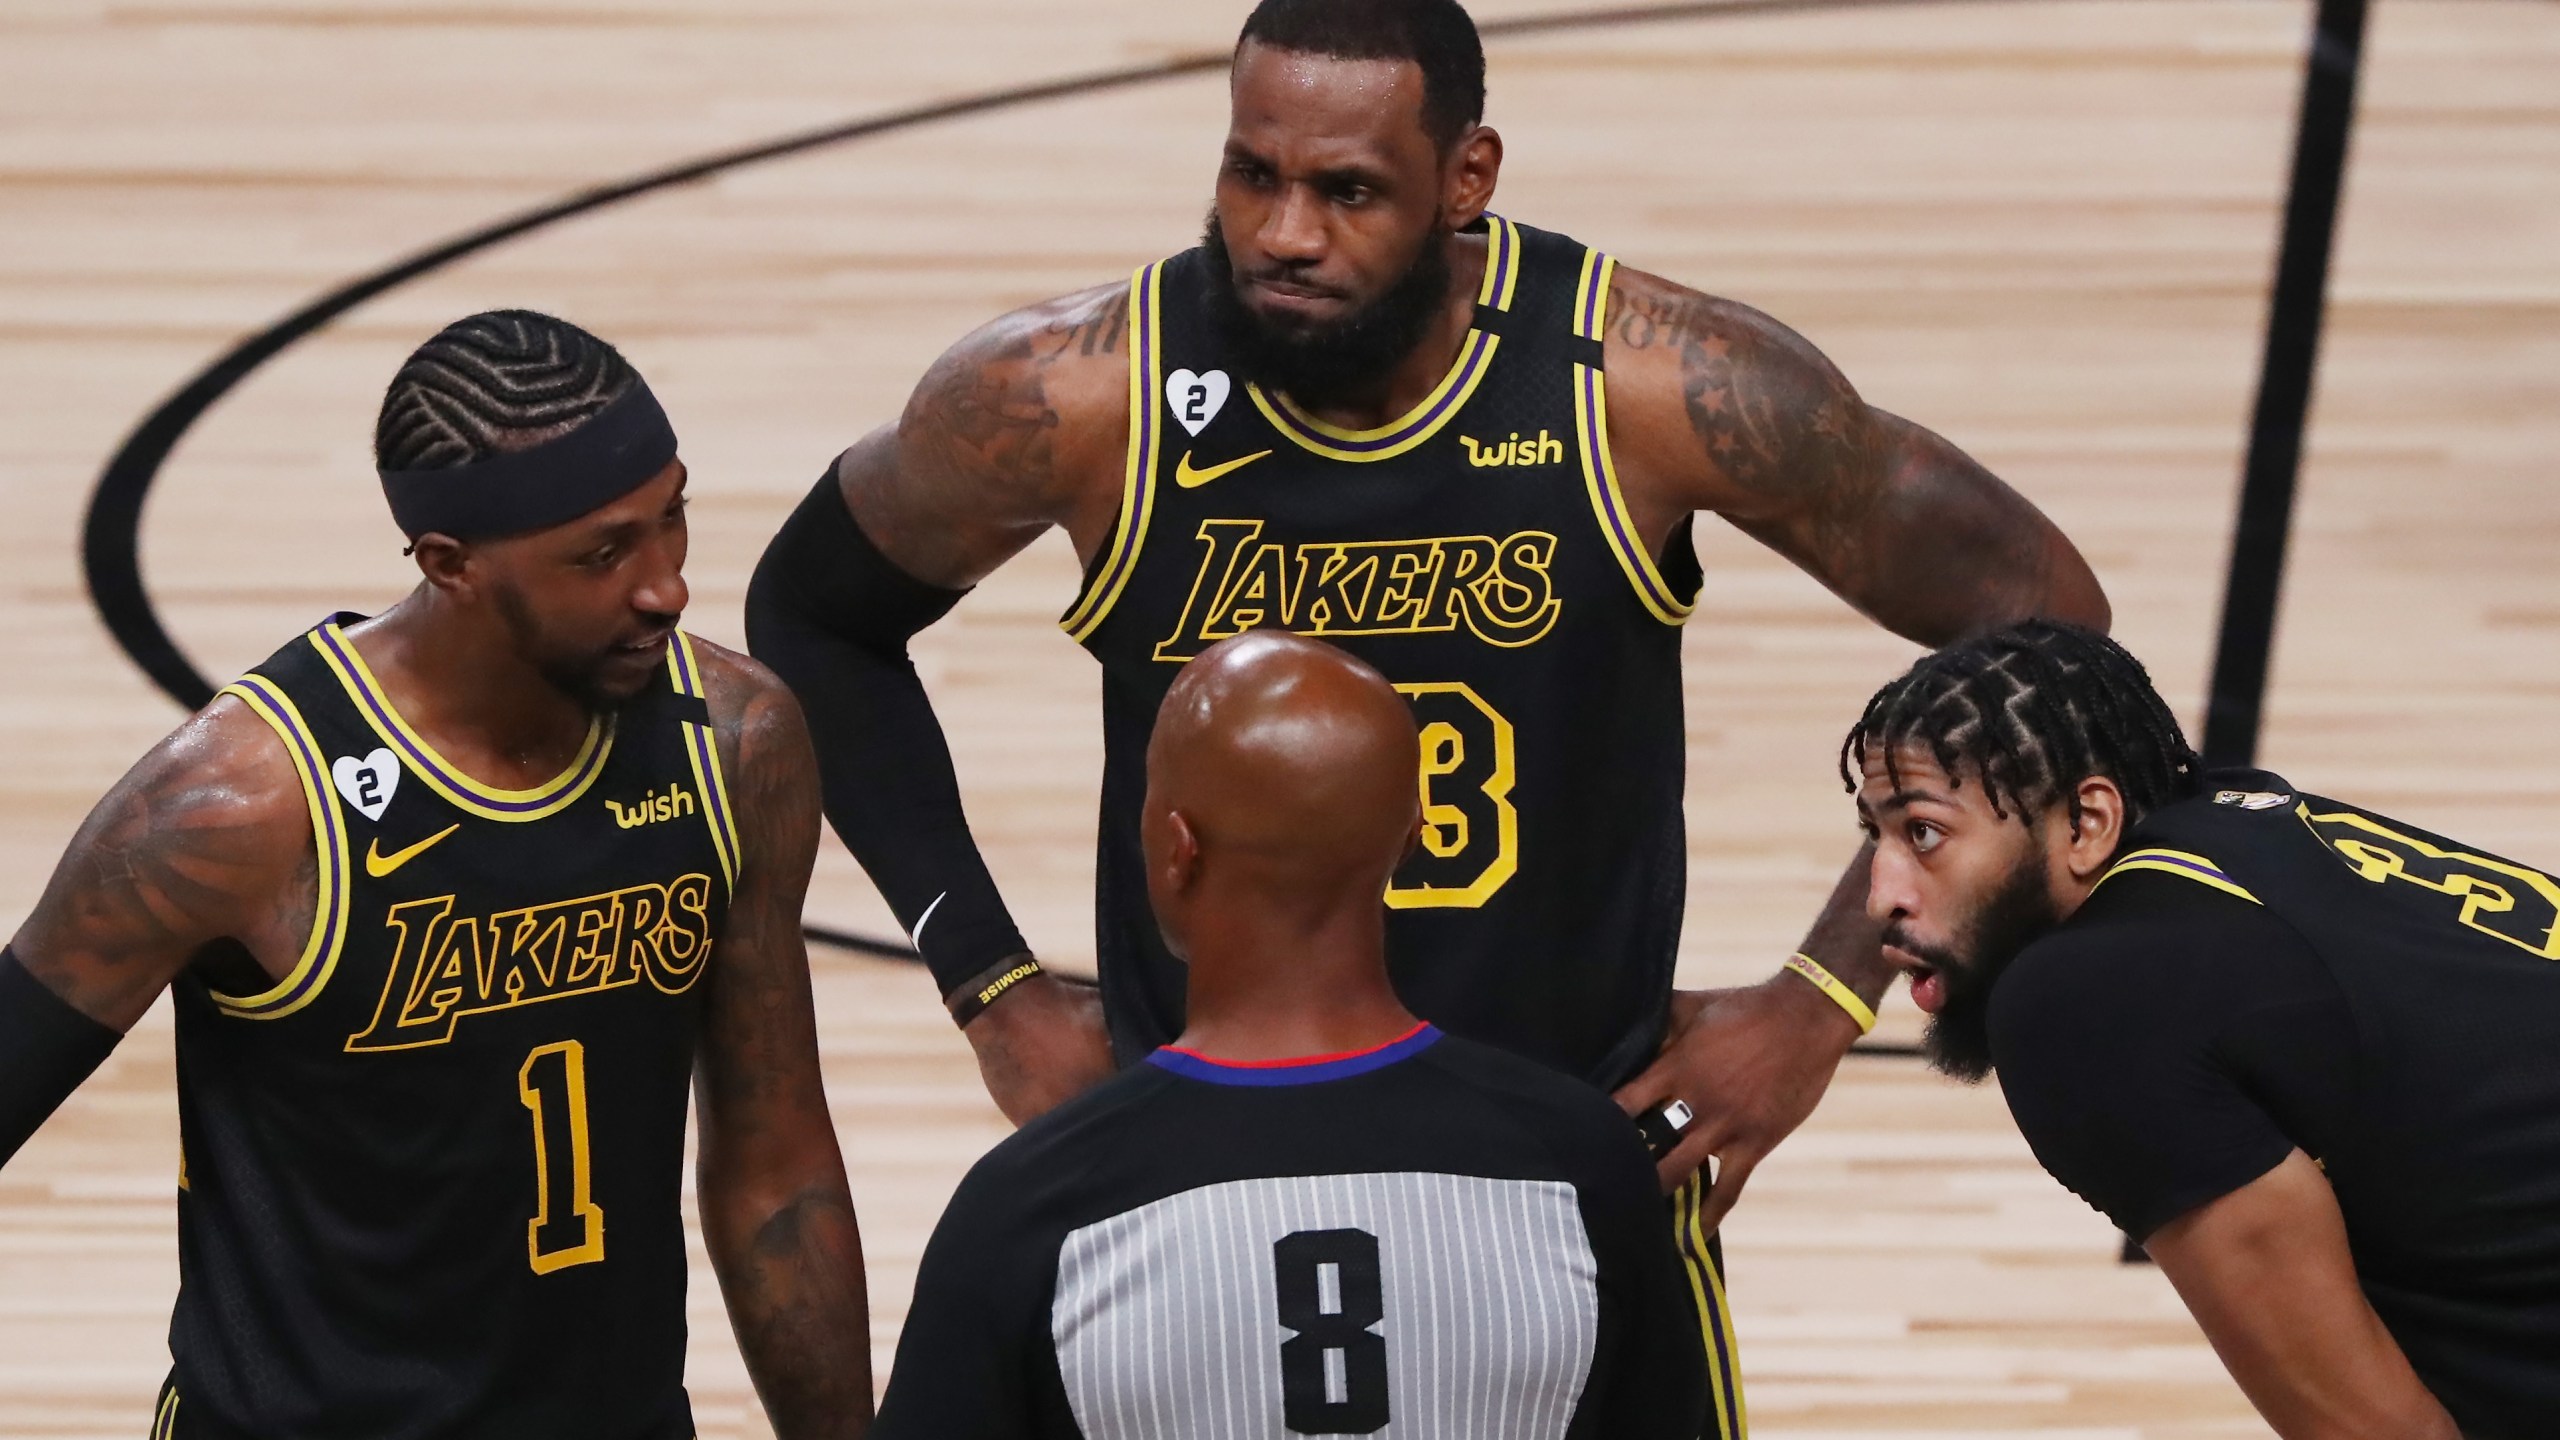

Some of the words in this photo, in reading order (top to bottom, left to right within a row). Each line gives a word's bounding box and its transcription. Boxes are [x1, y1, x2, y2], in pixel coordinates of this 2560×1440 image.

[1186, 384, 1207, 421] 2
[1460, 430, 1563, 467] wish
[1153, 518, 1563, 664] LAKERS
[356, 767, 383, 807] 2
[604, 782, 695, 830] wish
[2295, 800, 2560, 960] 3
[344, 873, 713, 1053] LAKERS
[978, 961, 1039, 1004] PROMISE
[518, 1039, 605, 1275] 1
[1273, 1227, 1391, 1435] 8
